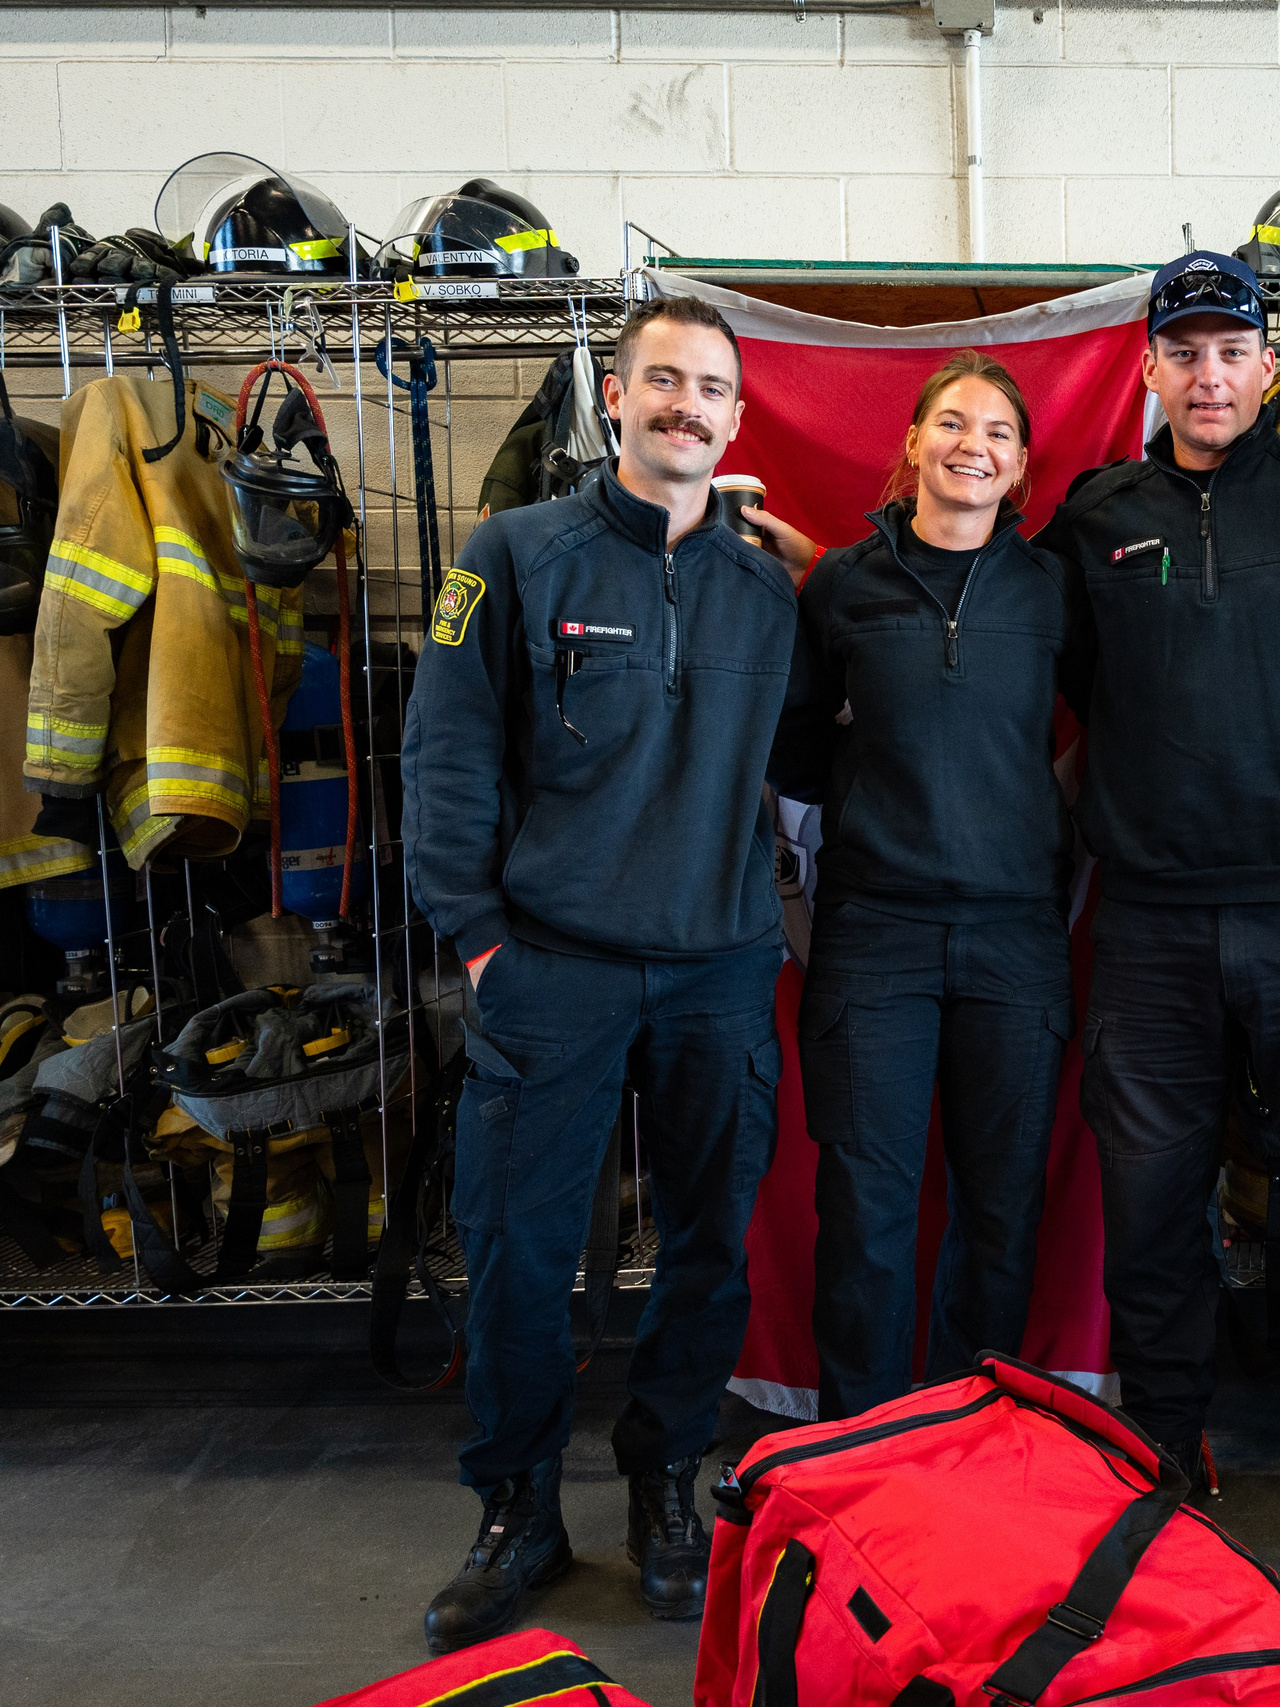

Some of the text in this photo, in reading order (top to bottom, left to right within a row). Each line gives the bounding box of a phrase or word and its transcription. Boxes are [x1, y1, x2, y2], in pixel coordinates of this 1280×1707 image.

[148, 289, 198, 300] TMINI
[423, 284, 481, 296] V. SOBKO
[1125, 539, 1160, 553] FIREFIGHTER
[457, 574, 477, 588] SOUND
[585, 625, 633, 637] FIREFIGHTER
